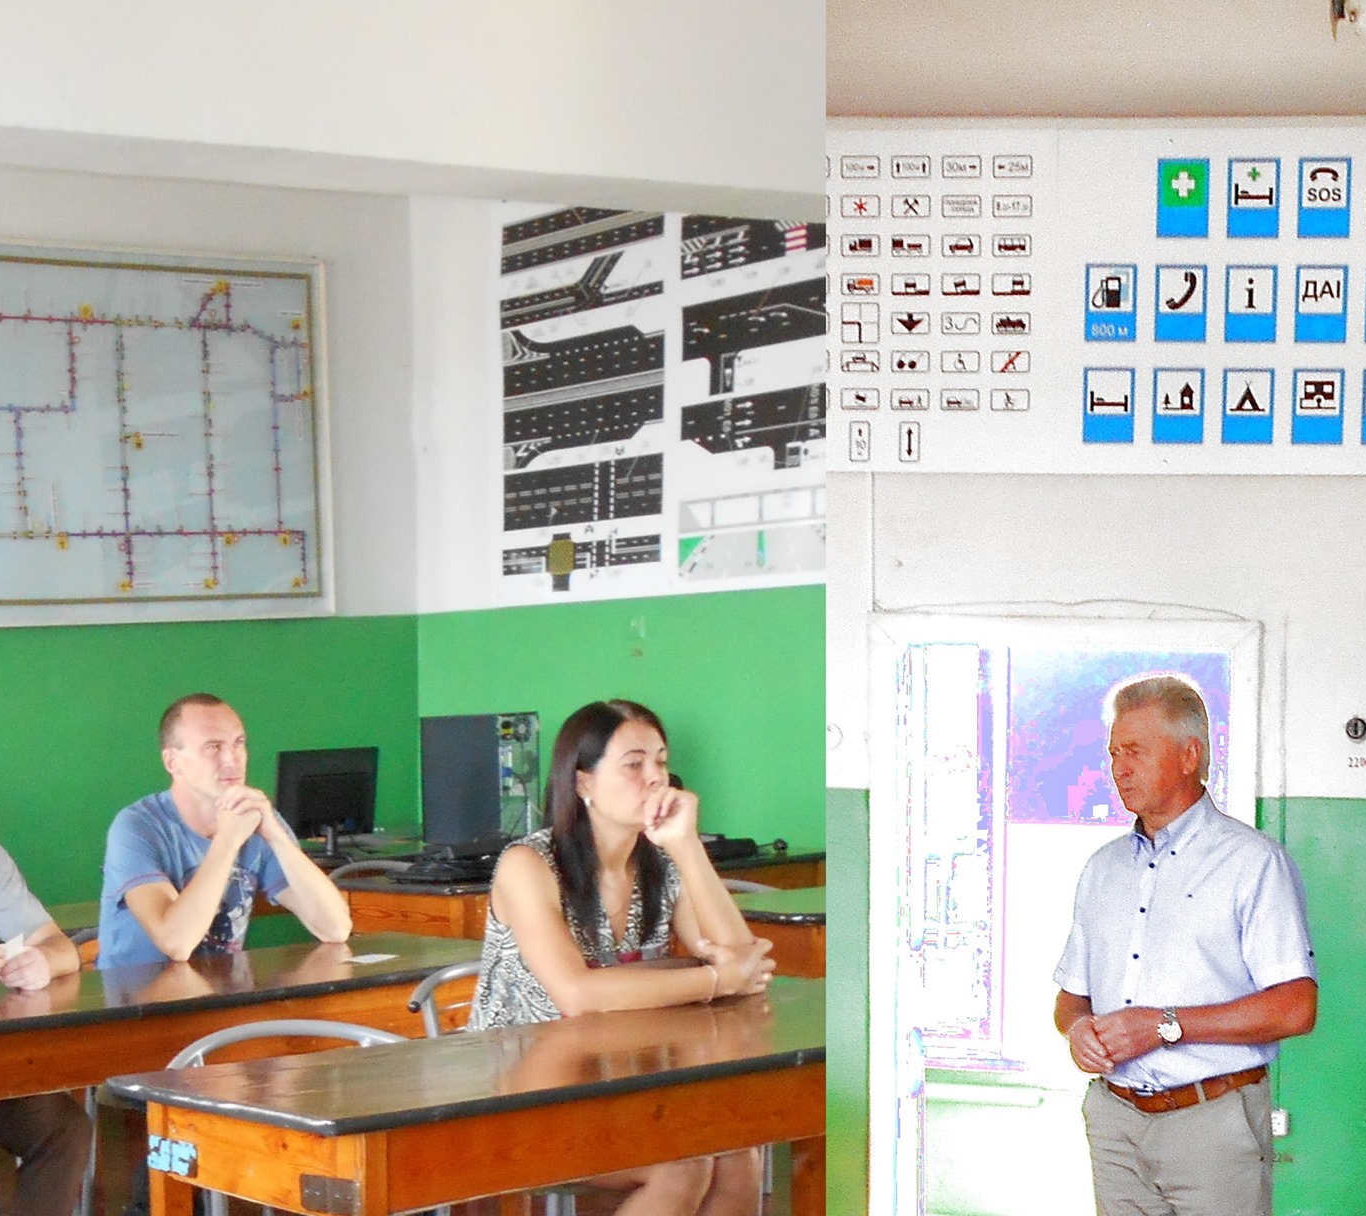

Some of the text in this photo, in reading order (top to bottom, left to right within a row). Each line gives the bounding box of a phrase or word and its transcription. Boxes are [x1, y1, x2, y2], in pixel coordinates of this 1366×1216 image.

[1306, 187, 1342, 202] SOS
[1301, 280, 1341, 302] ДАІ
[1091, 323, 1115, 337] 800
